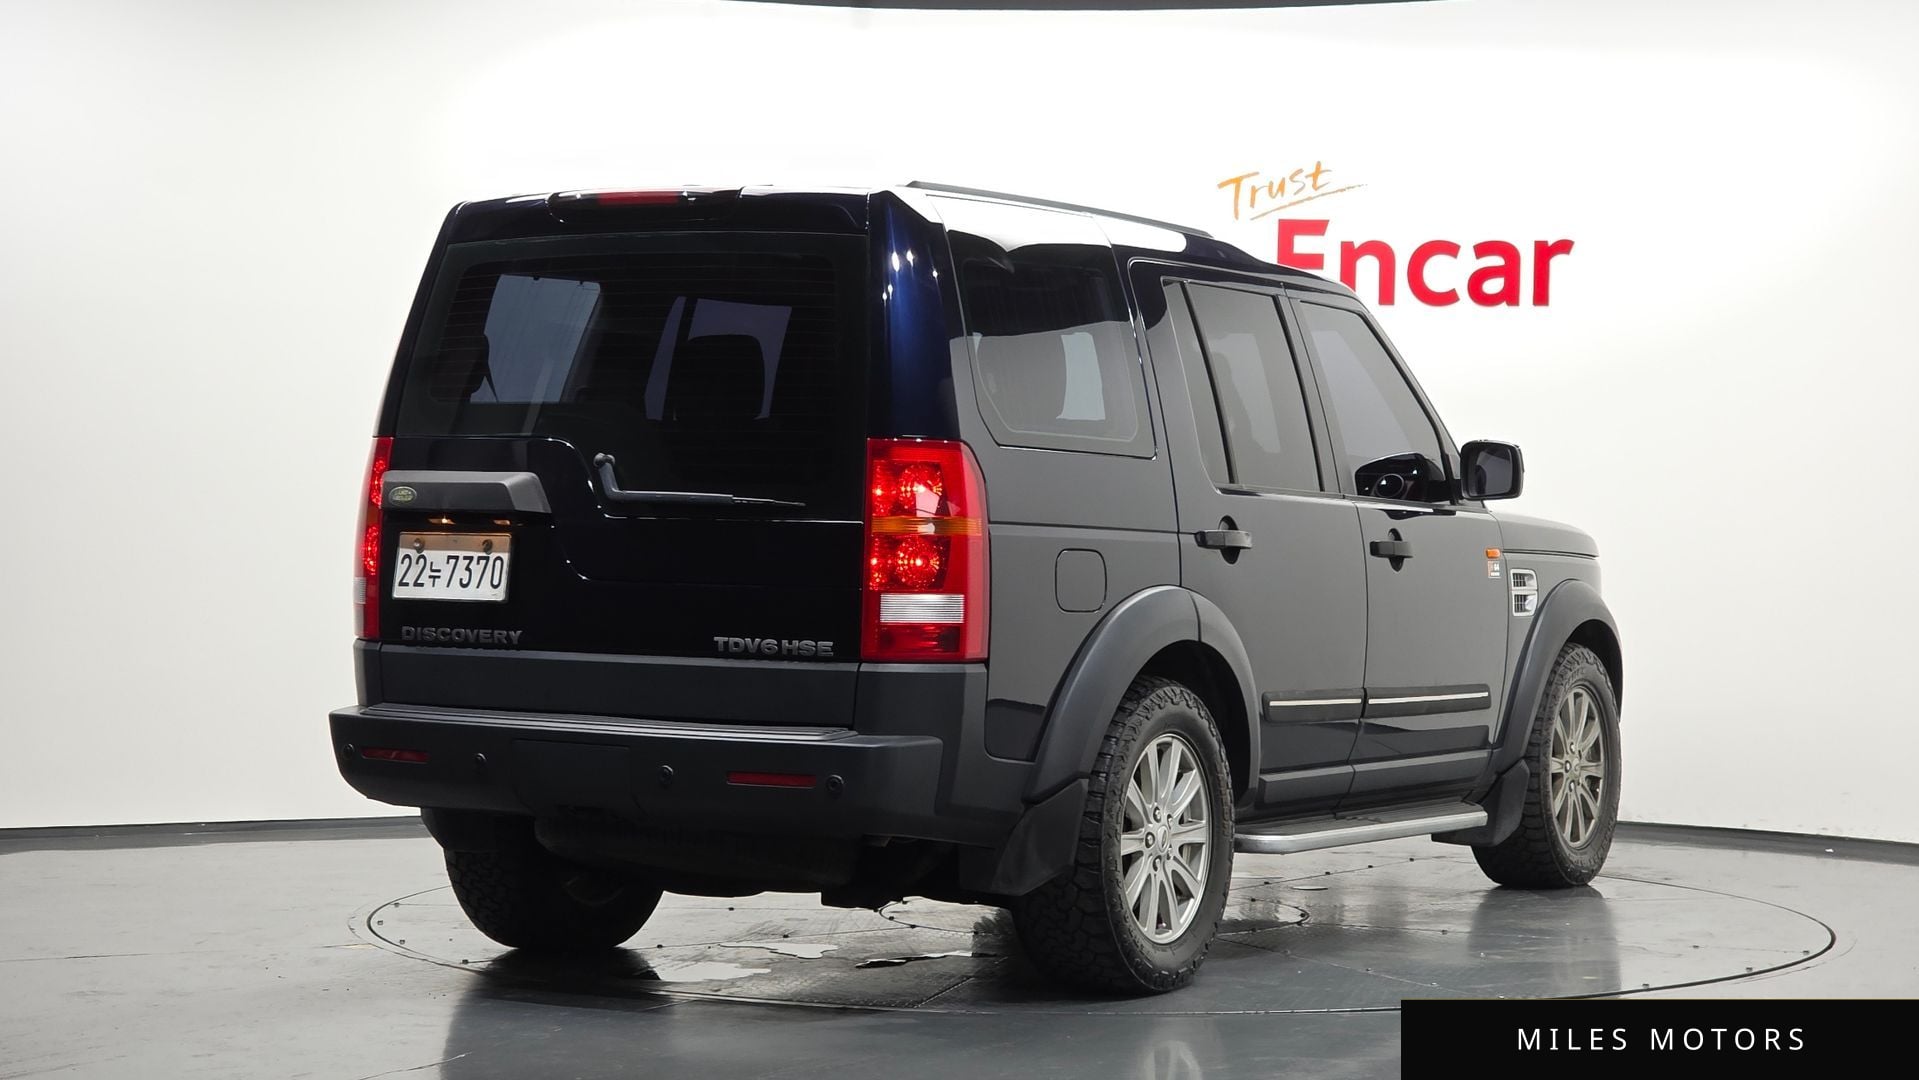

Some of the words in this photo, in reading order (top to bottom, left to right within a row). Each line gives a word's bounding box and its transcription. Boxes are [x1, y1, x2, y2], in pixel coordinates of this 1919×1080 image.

[1218, 161, 1334, 221] Trust
[1277, 219, 1574, 307] Encar
[398, 553, 504, 590] 22누7370
[401, 626, 523, 644] DISCOVERY
[713, 636, 778, 655] TDV6
[781, 639, 834, 657] HSE
